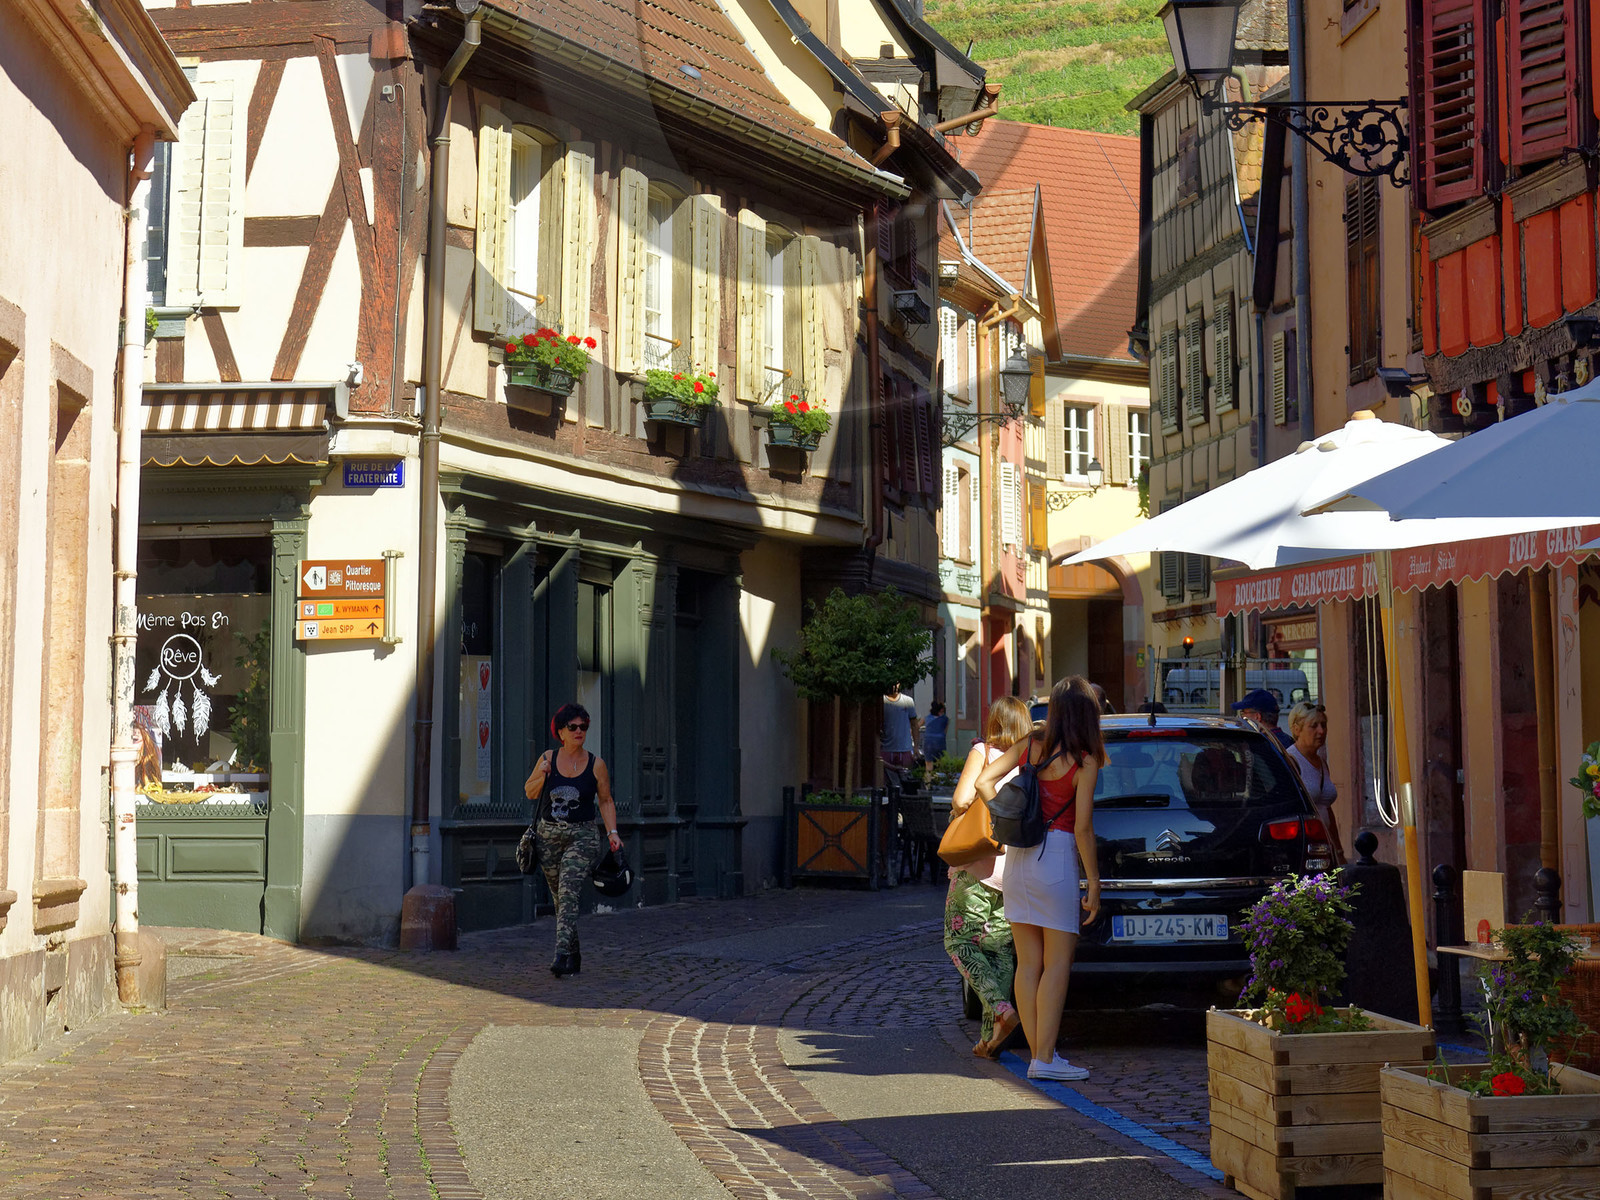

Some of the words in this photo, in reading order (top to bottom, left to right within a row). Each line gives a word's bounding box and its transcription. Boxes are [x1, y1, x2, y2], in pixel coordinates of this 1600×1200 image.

[350, 463, 368, 471] RUE
[371, 463, 382, 471] DE
[385, 463, 396, 471] LA
[1509, 532, 1538, 564] FOIE
[1546, 527, 1582, 555] GRAS
[345, 564, 371, 576] Quartier
[345, 580, 381, 592] Pittoresque
[1235, 577, 1282, 606] BOUCHERIE
[1291, 565, 1357, 598] CHARCUTERIE
[342, 605, 369, 613] WYMANN
[136, 613, 175, 631] Même
[180, 611, 207, 629] Pas
[211, 611, 230, 629] En
[322, 625, 338, 634] Jean
[339, 624, 354, 634] SIPP
[1281, 622, 1317, 642] MERCERIE
[163, 647, 197, 668] Rêve
[1125, 917, 1214, 937] DJ-245-KM
[1217, 926, 1227, 936] 68
